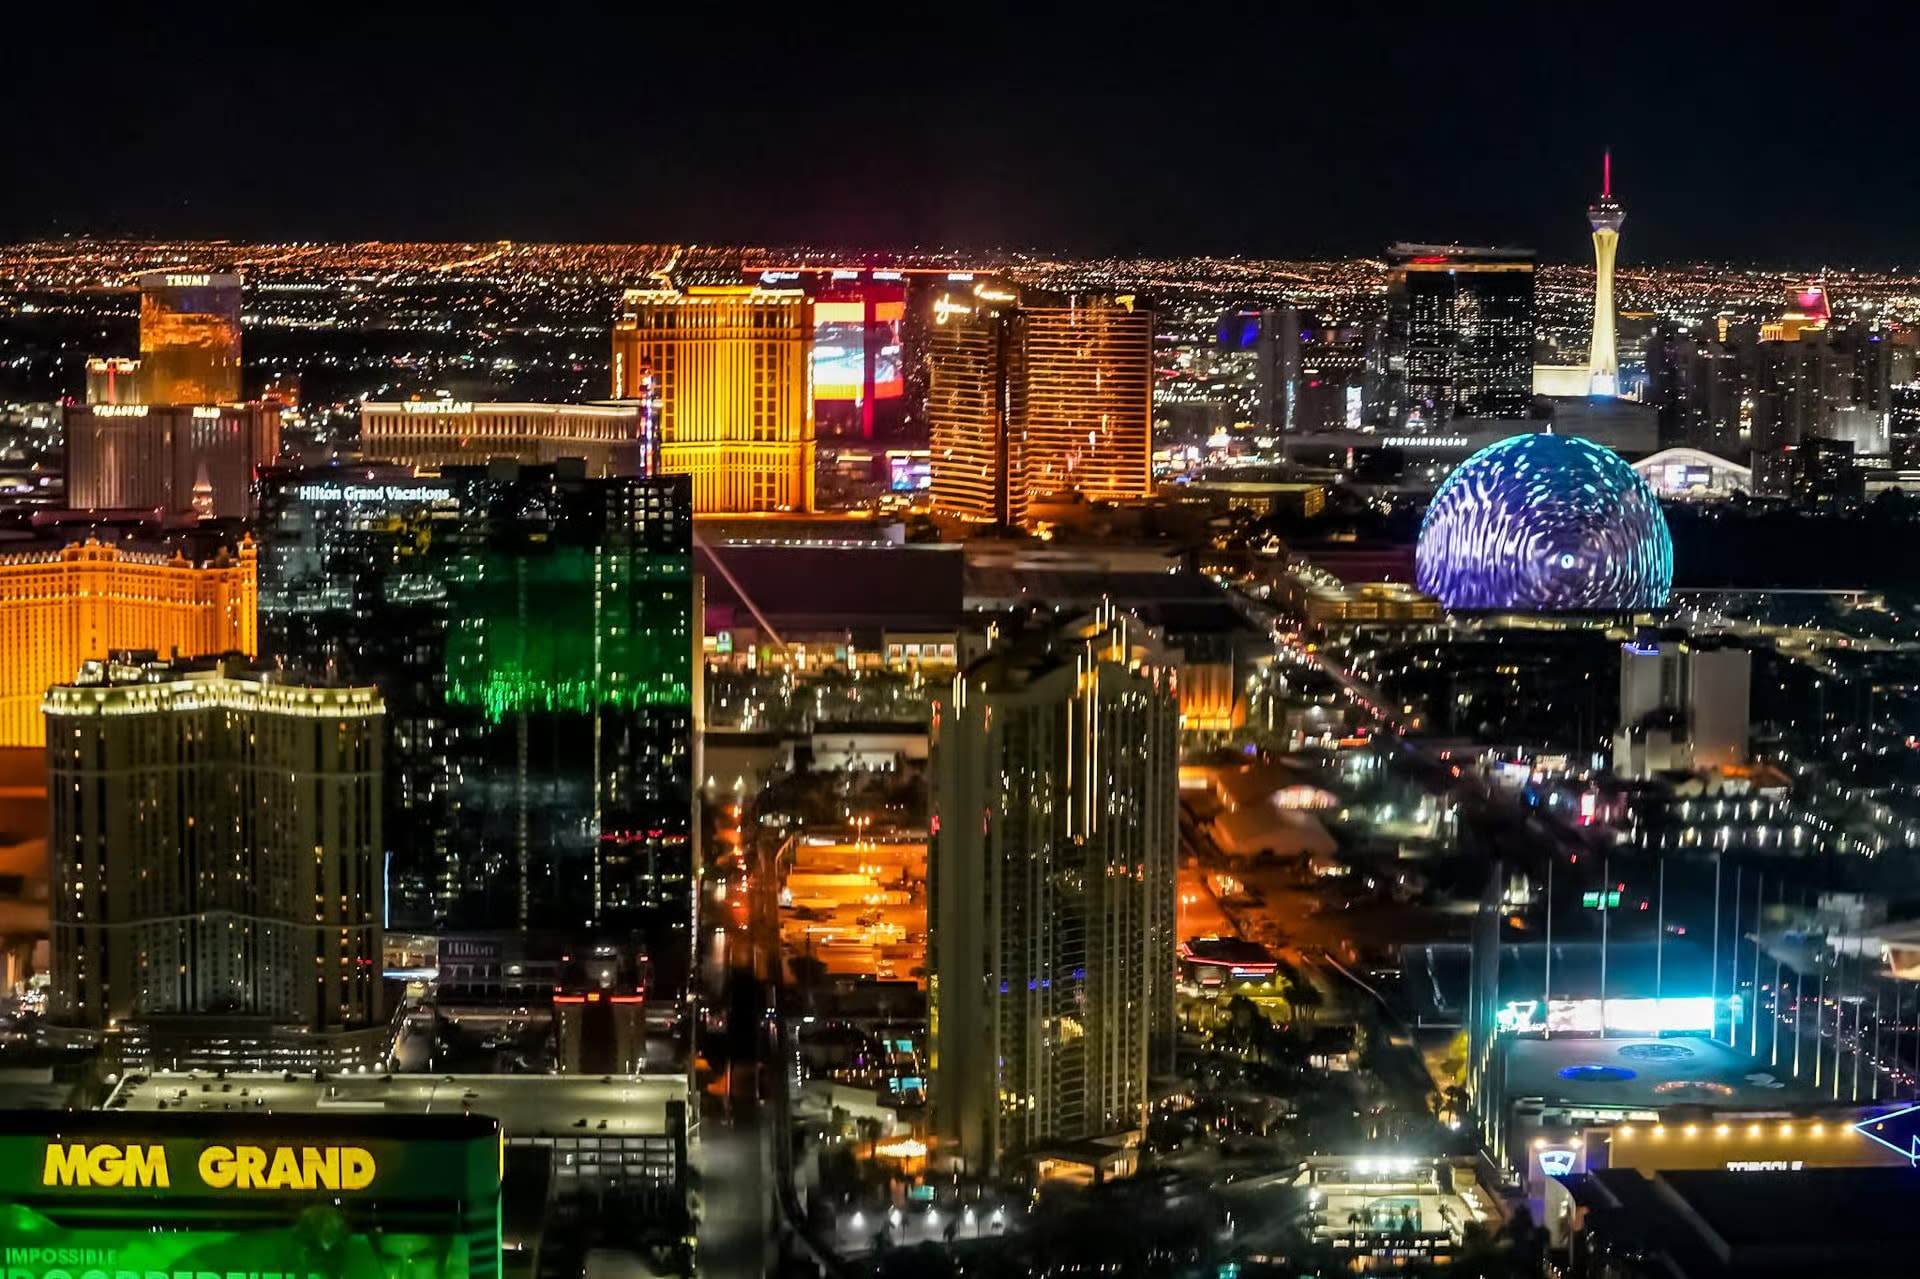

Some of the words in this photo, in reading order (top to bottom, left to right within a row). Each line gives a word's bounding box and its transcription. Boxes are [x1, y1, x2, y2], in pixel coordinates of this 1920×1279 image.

[165, 274, 211, 286] TRUMP
[299, 486, 342, 501] Hilton
[343, 486, 385, 501] Grand
[386, 486, 450, 502] Vacations
[448, 941, 495, 956] Hilton
[43, 1143, 170, 1188] MGM
[198, 1145, 377, 1190] GRAND
[5, 1247, 117, 1265] IMPOSSIBLE
